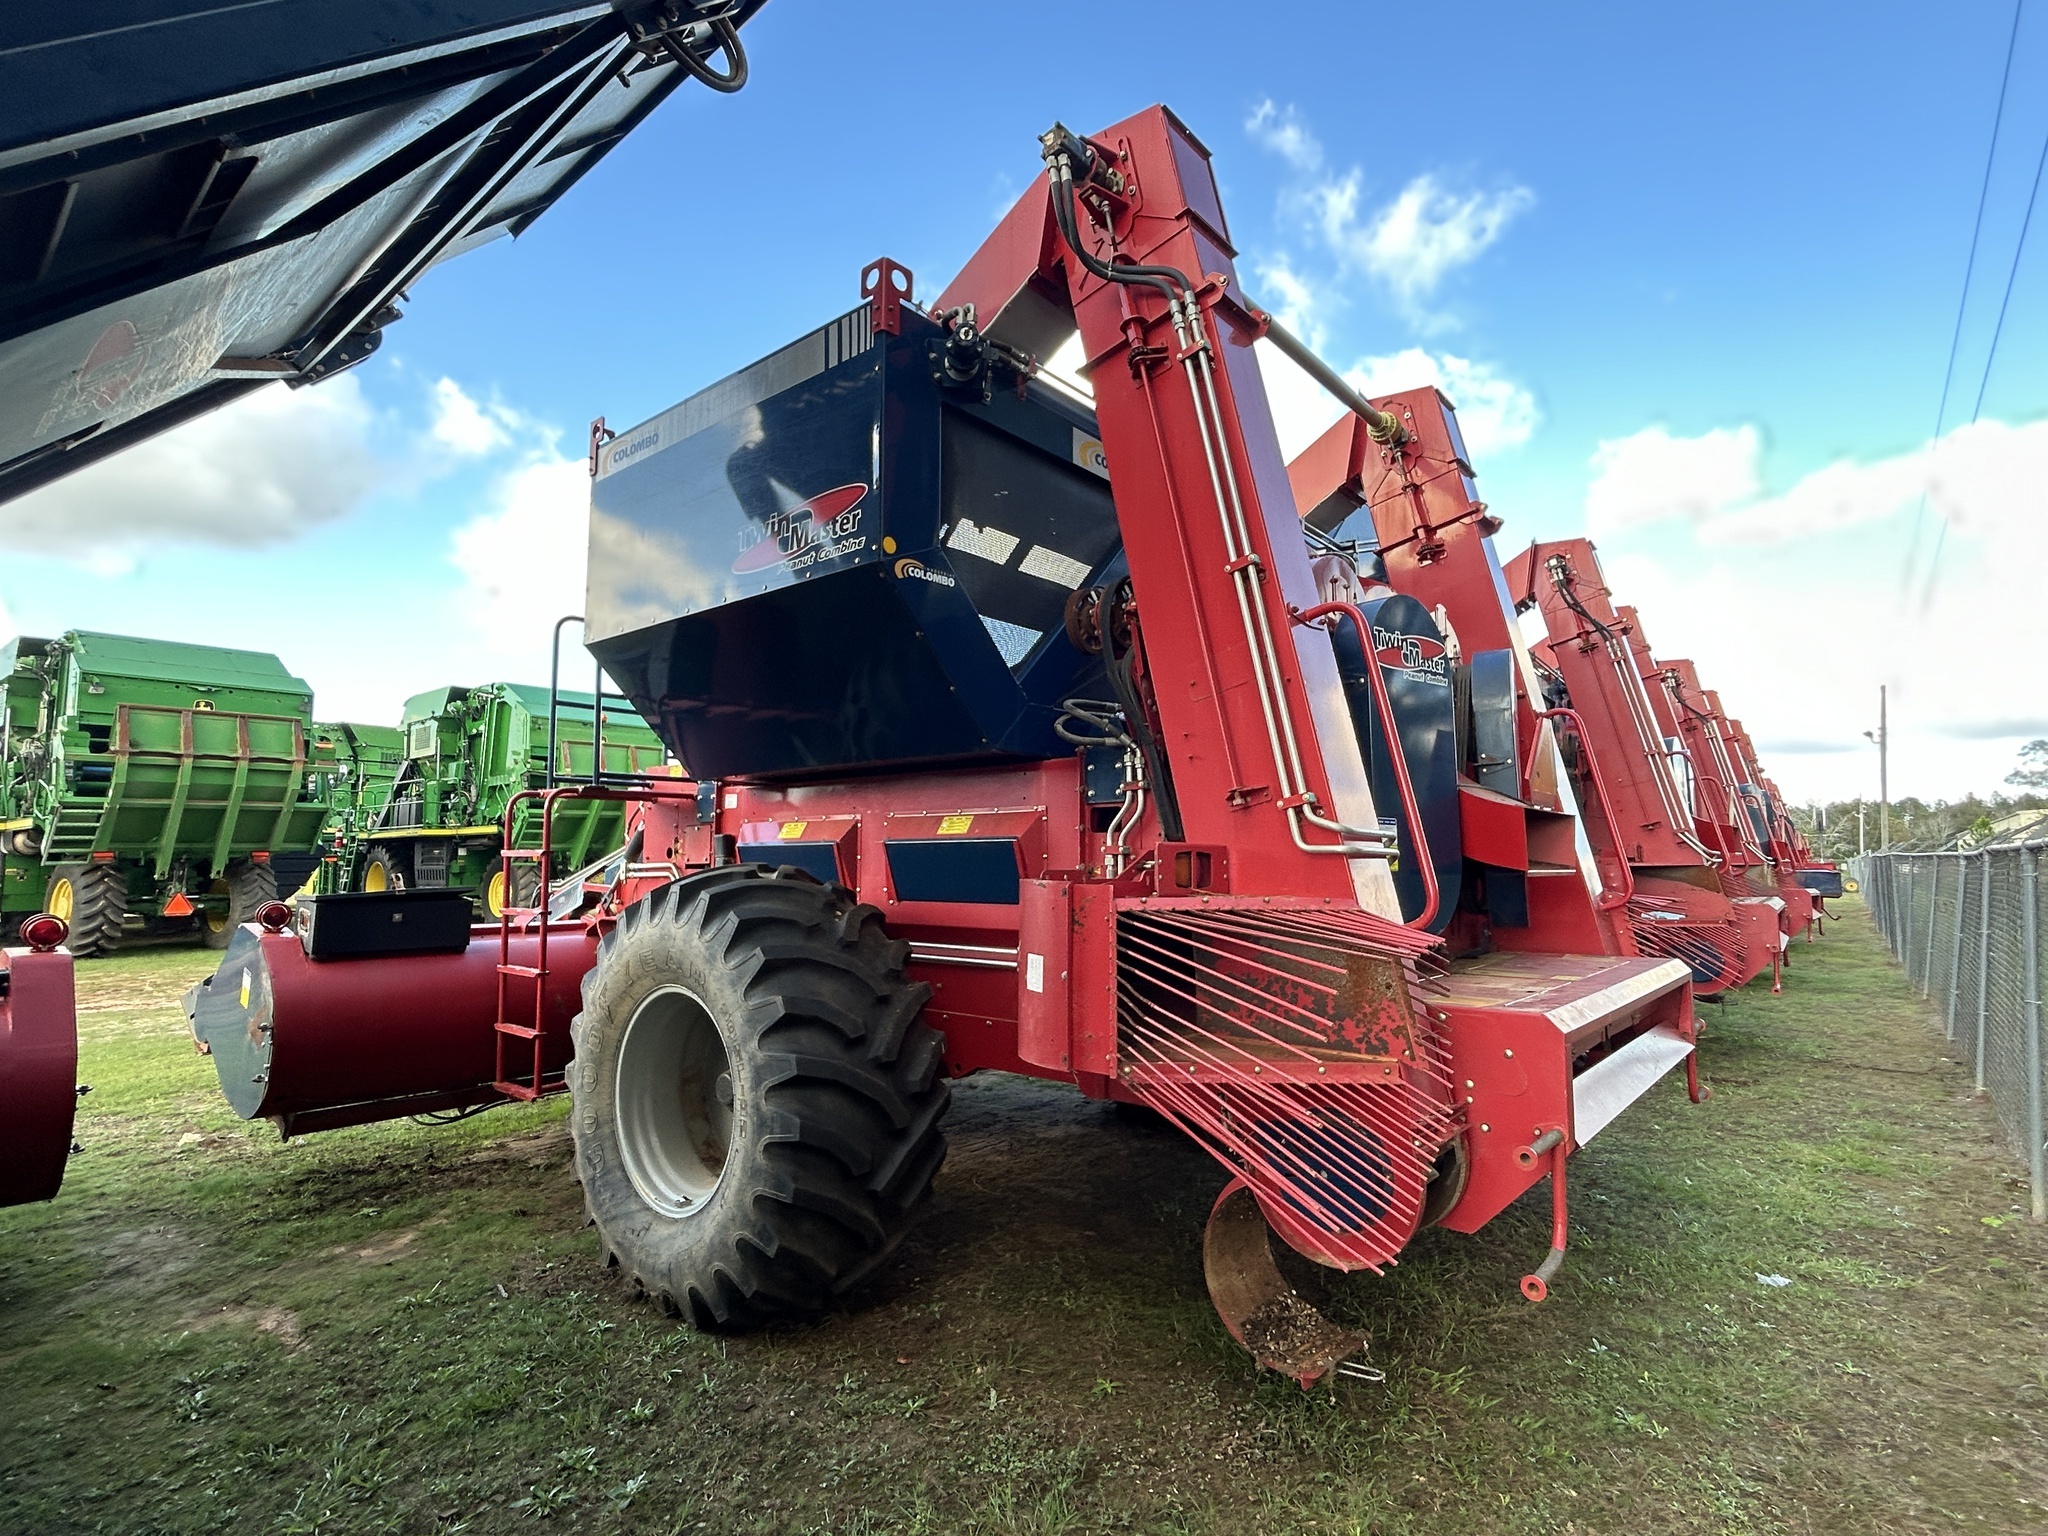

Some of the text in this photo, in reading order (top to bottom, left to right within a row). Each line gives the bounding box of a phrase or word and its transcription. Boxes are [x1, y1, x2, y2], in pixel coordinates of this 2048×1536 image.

[613, 432, 659, 464] COLOMBO
[738, 512, 791, 552] Twin
[788, 509, 862, 552] Master
[777, 536, 866, 575] Peanut Combine
[908, 566, 955, 588] COLOMBO
[1374, 626, 1408, 653] Twin
[1406, 646, 1445, 673] Master
